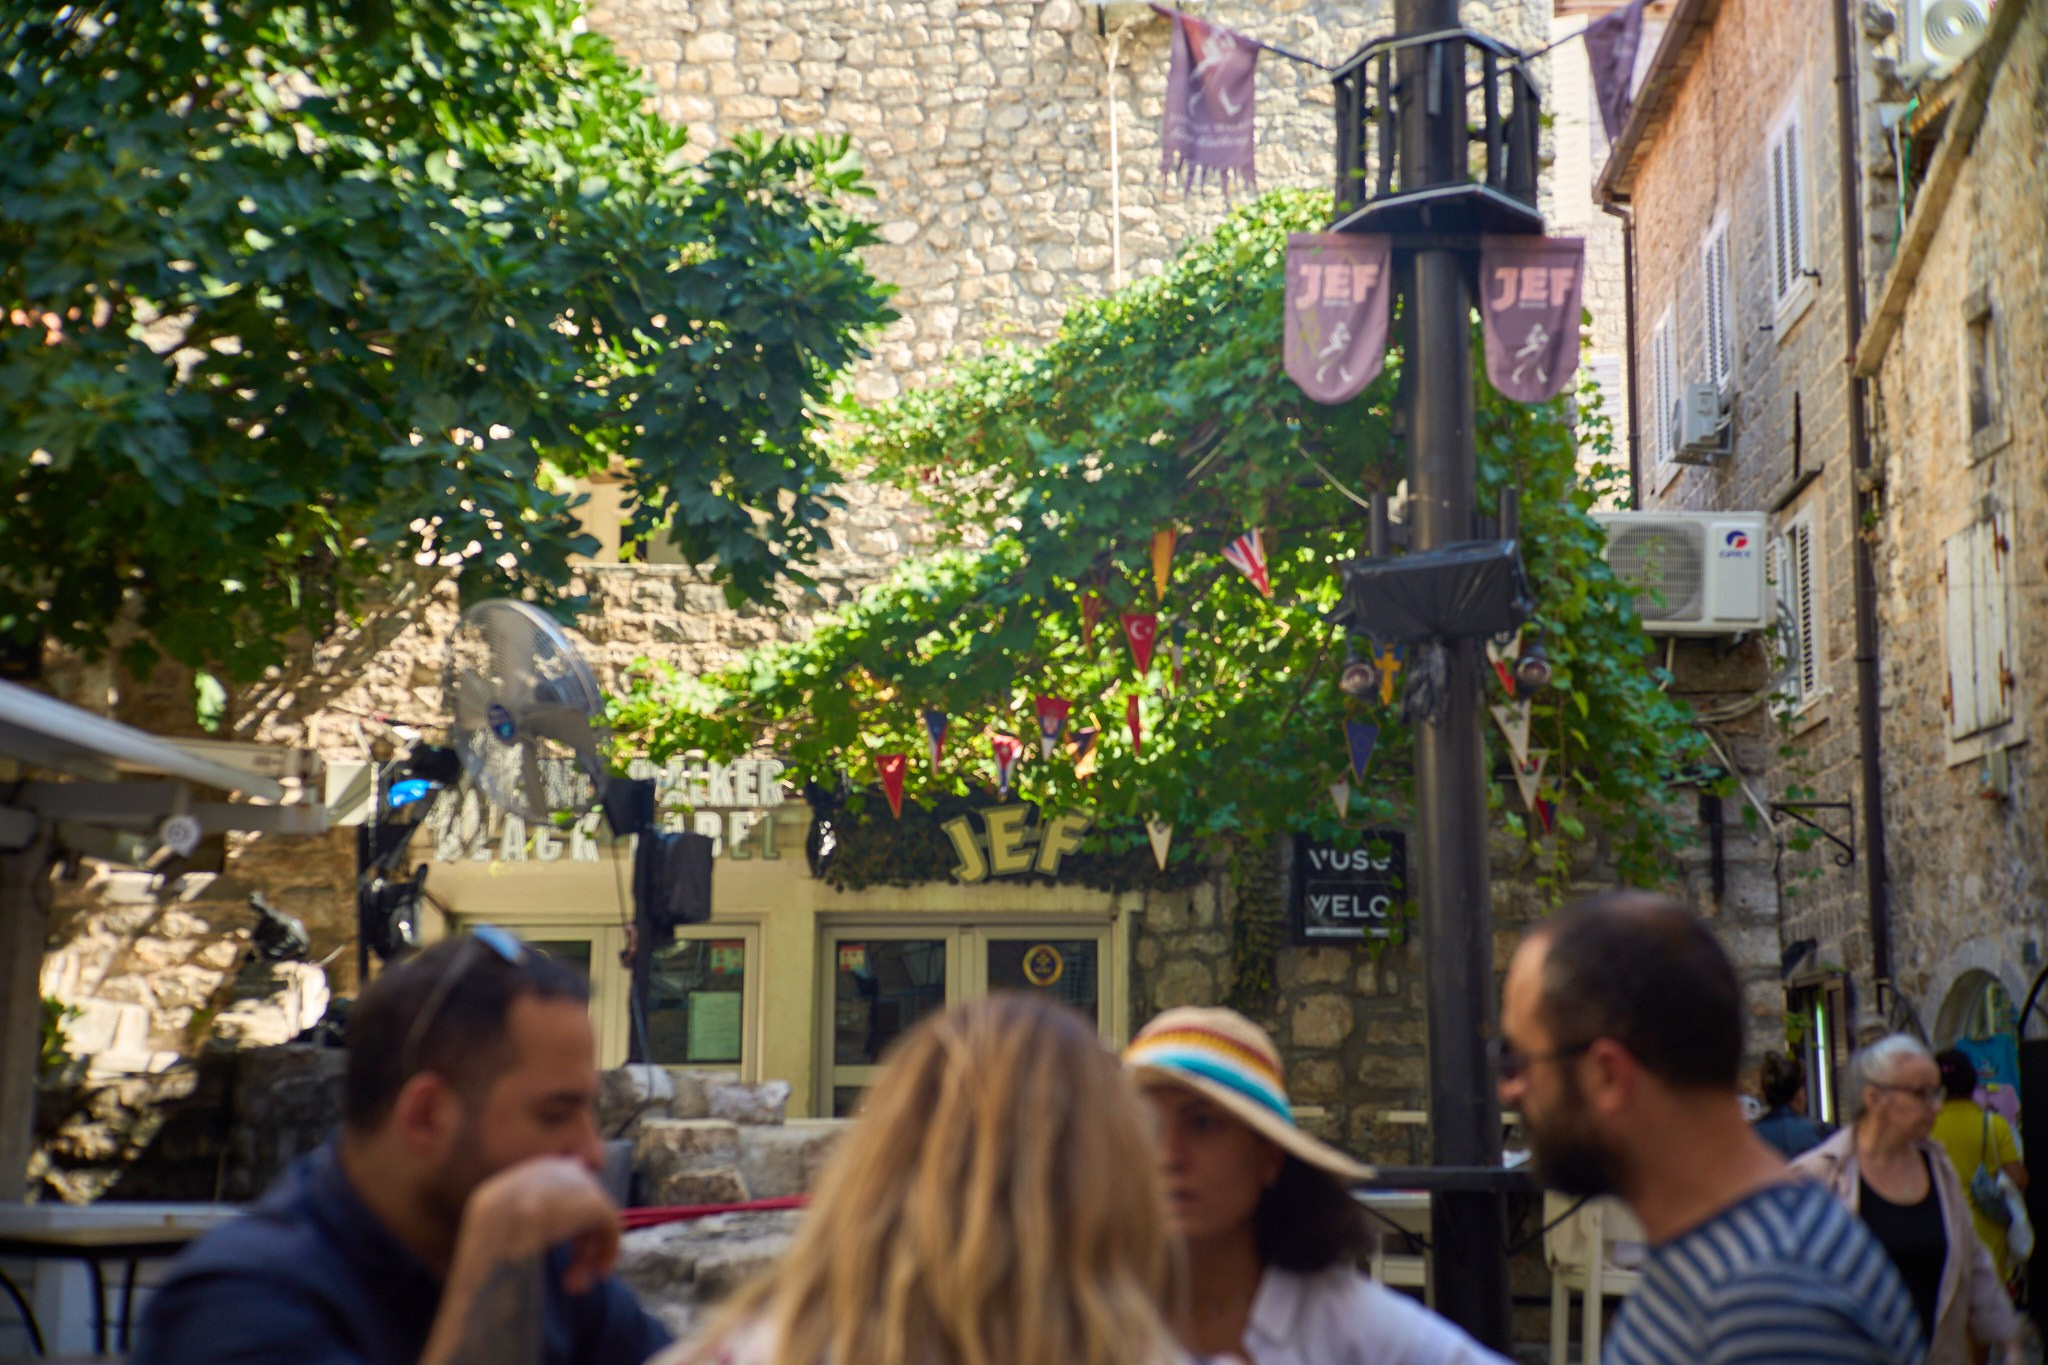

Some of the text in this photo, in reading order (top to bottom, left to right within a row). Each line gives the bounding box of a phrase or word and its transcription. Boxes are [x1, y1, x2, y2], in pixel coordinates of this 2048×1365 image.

[1295, 264, 1379, 309] JEF
[1491, 267, 1574, 311] JEF
[629, 811, 781, 860] BEL
[940, 803, 1093, 884] JEF
